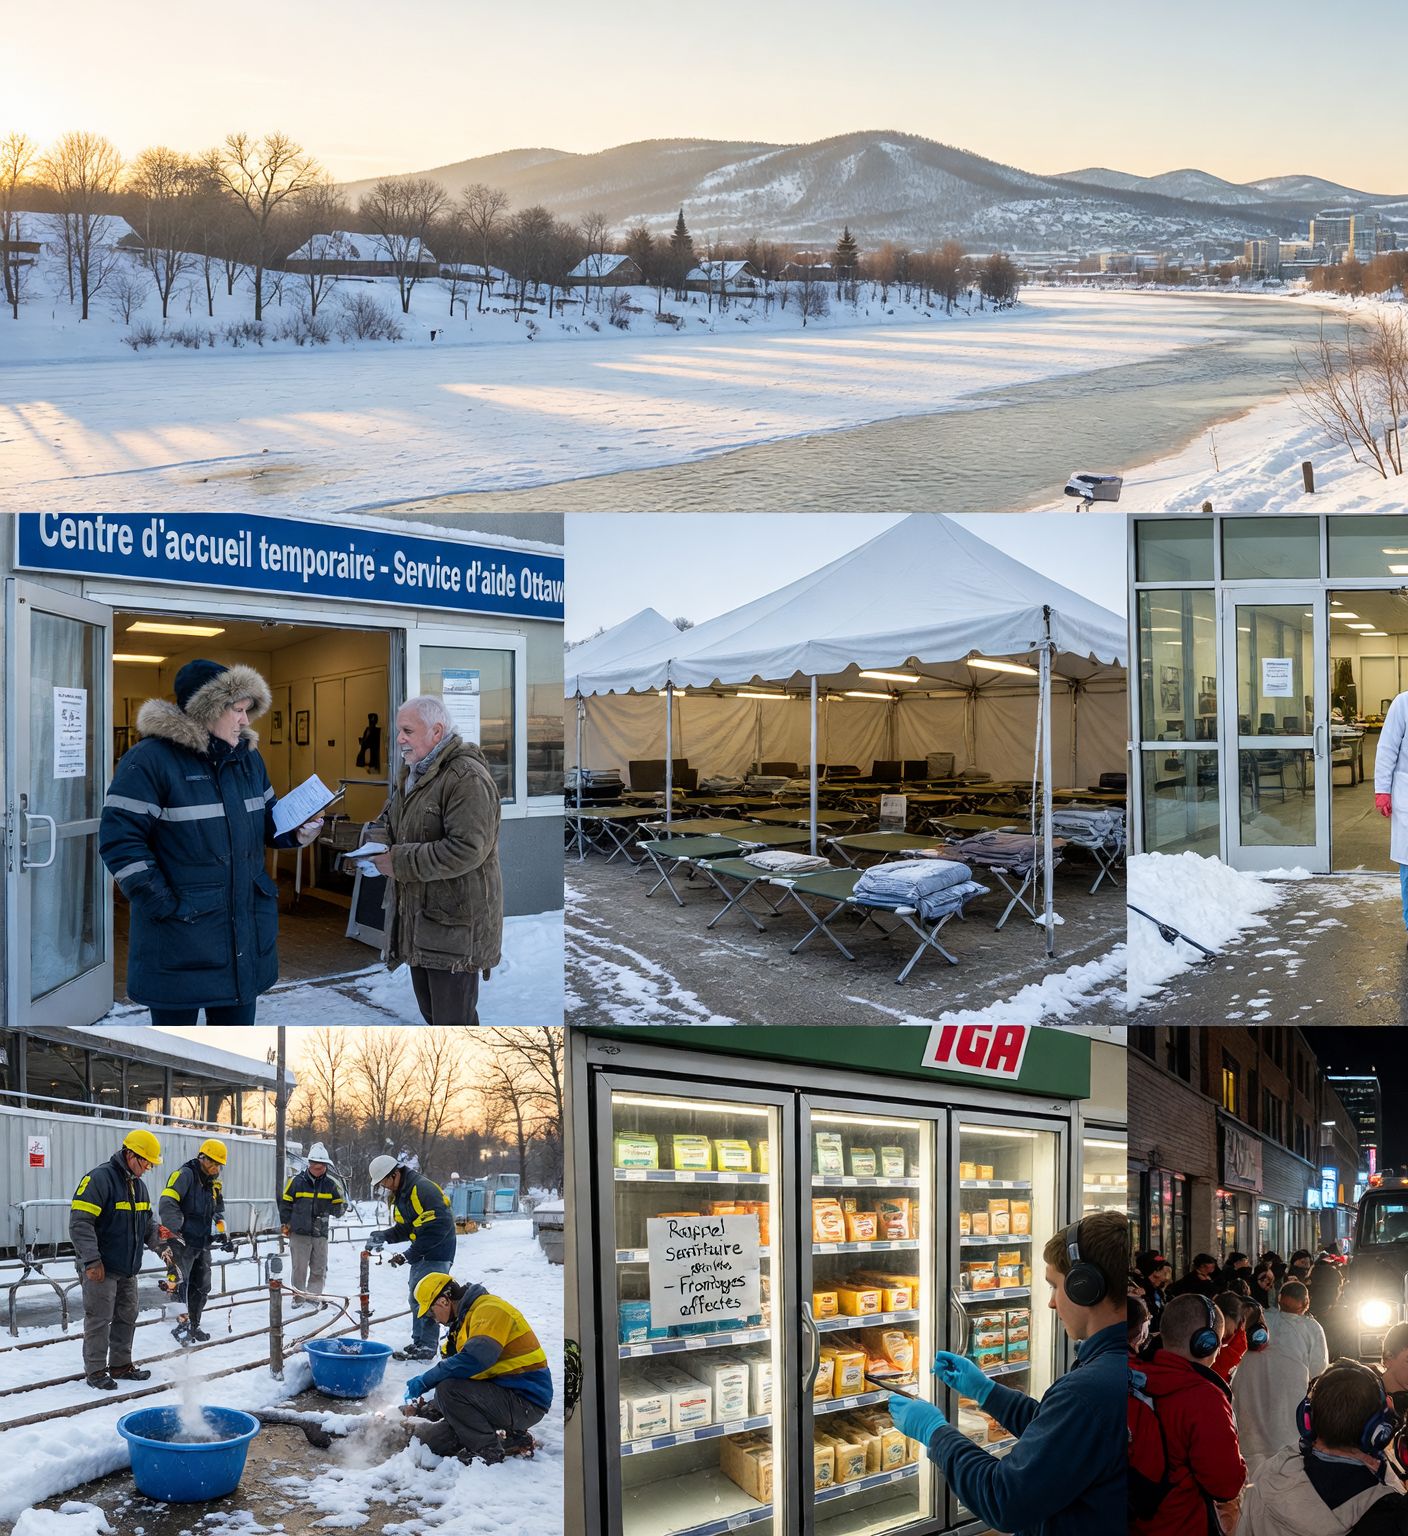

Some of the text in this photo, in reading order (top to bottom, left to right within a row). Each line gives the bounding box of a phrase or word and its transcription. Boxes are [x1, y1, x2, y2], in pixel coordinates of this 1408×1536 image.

[39, 512, 134, 555] Centre
[141, 518, 252, 568] d'accueil
[259, 535, 375, 583] temporaire
[393, 550, 461, 592] Service
[466, 560, 516, 598] d'aide
[934, 1025, 1026, 1073] IGA
